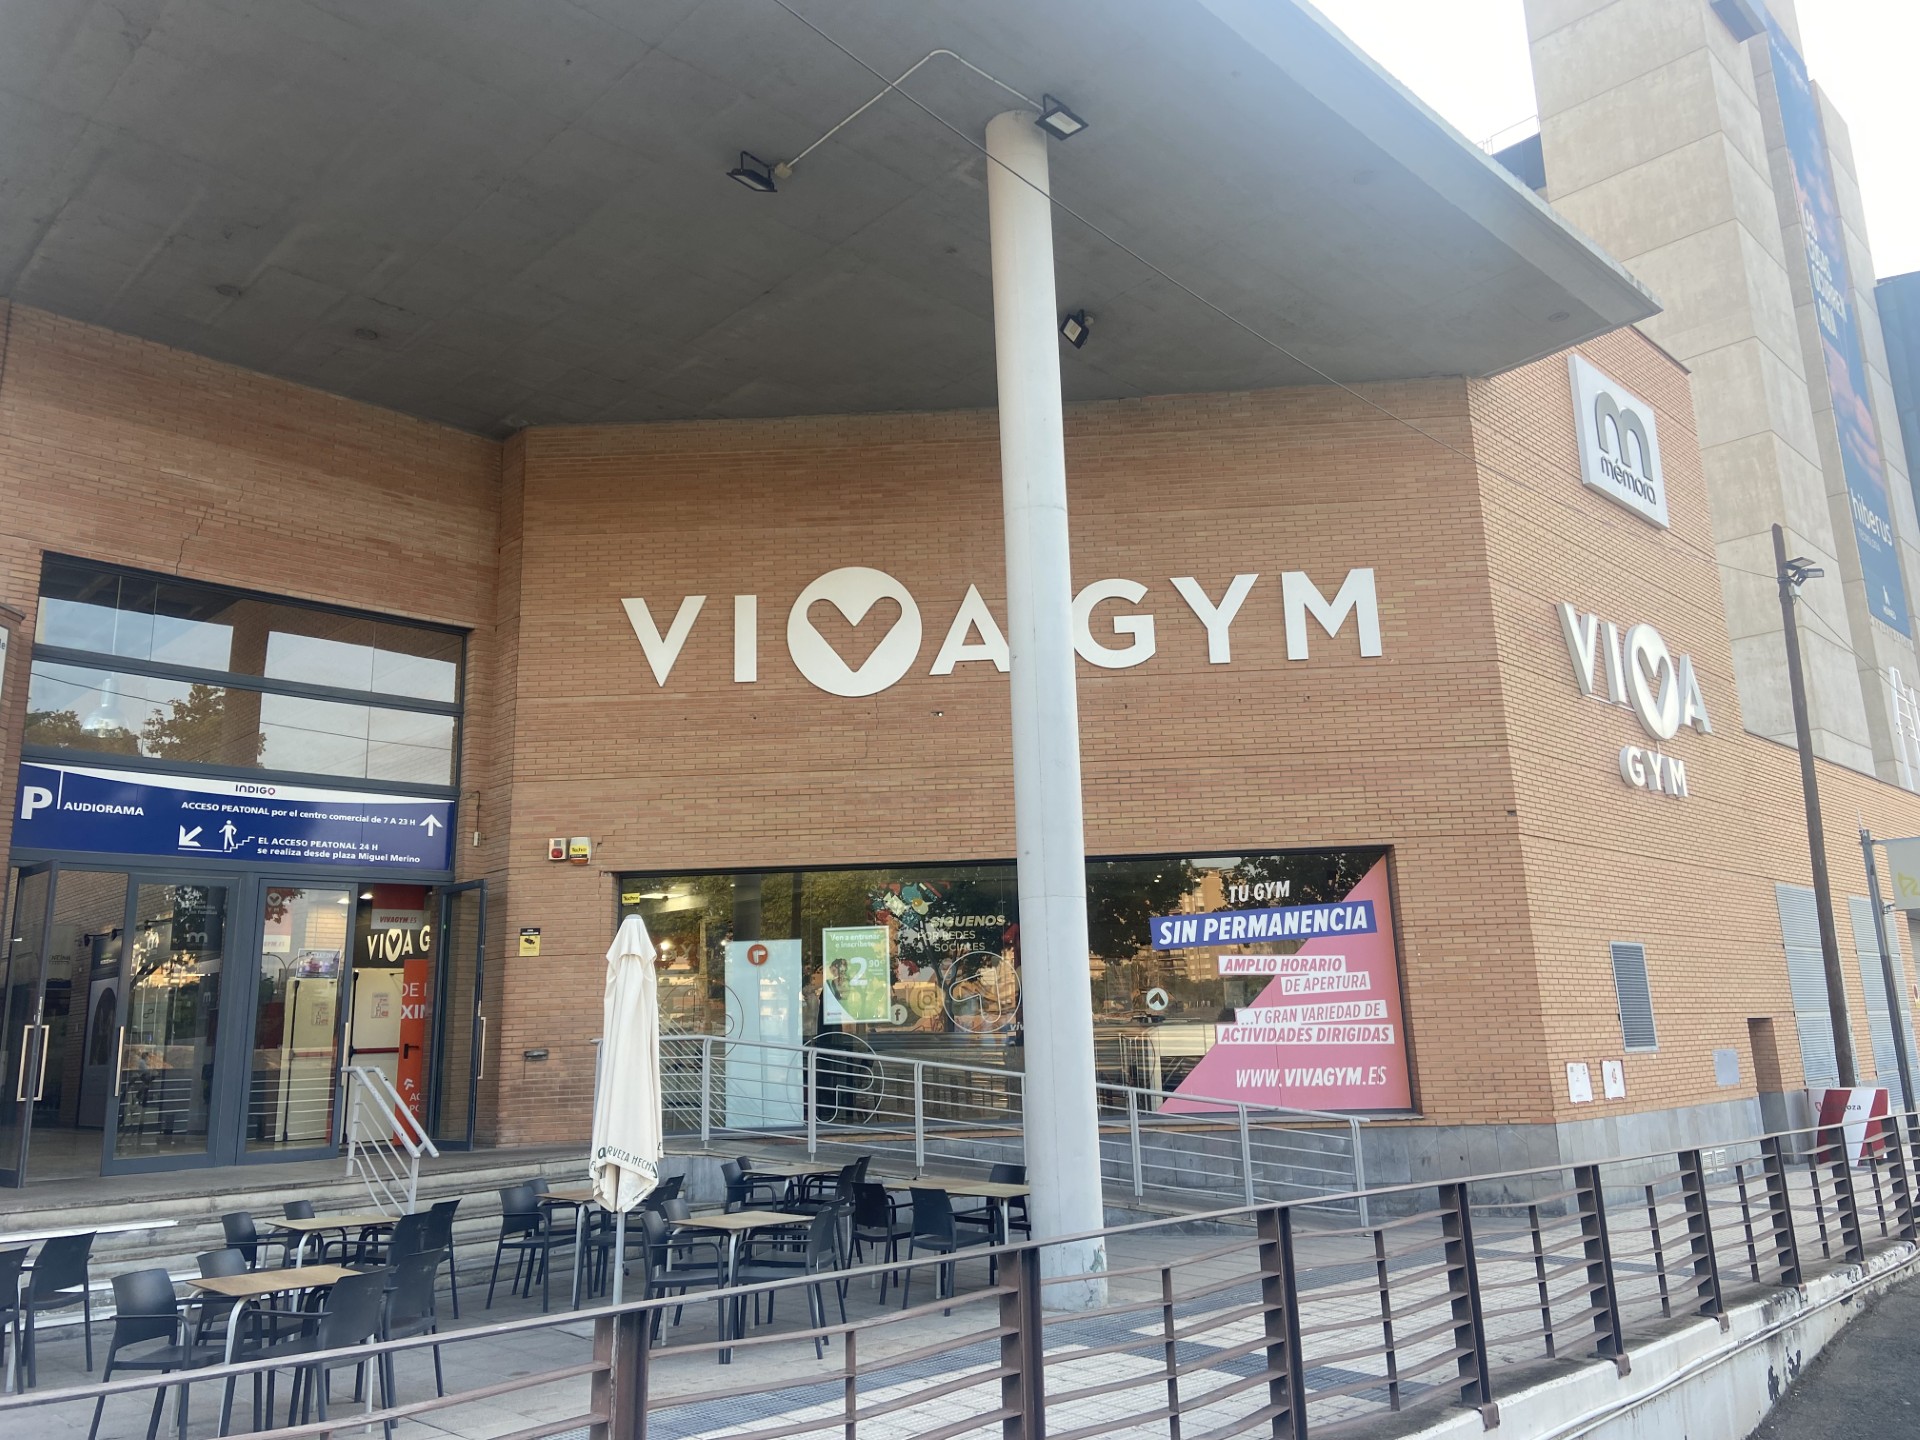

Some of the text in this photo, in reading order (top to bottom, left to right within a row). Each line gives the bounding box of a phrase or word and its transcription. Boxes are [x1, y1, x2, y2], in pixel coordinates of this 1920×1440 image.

[1600, 456, 1657, 506] mémora
[1850, 487, 1893, 547] hiberus
[1618, 745, 1689, 798] GYM
[235, 784, 276, 796] INDIGO
[21, 785, 145, 820] P AUDIORAMA
[181, 801, 220, 812] ACCESO
[221, 804, 270, 816] PEATONAL
[271, 809, 287, 818] por
[289, 809, 298, 818] el
[299, 811, 328, 820] centro
[329, 813, 370, 823] comercial
[370, 815, 382, 824] de
[390, 817, 397, 825] A
[398, 818, 408, 826] 23
[258, 836, 269, 845] EL
[271, 838, 308, 847] ACCESO
[310, 840, 357, 850] PEATONAL
[359, 843, 370, 851] 24
[257, 847, 421, 863] se realiza desde plaza Miguel Merino
[1228, 880, 1290, 903] TU GYM
[380, 915, 417, 924] VIVAGYM.ES
[1158, 905, 1369, 945] SIN PERMANENCIA
[830, 933, 844, 942] Ven
[850, 933, 880, 941] entrenar
[941, 930, 976, 940] REDES
[934, 942, 986, 952] SOCIALES
[849, 956, 868, 986] 2
[1224, 957, 1342, 973] AMPLIO HORARIO
[1284, 974, 1367, 993] DE APERTURA
[1265, 1007, 1298, 1024] GRAN
[1301, 1004, 1362, 1022] VARIEDAD
[1365, 1002, 1380, 1017] DE
[1220, 1026, 1390, 1043] ACTIVIDADES DIRIGIDAS
[1236, 1066, 1387, 1088] WWW.VIVAGYM.ES
